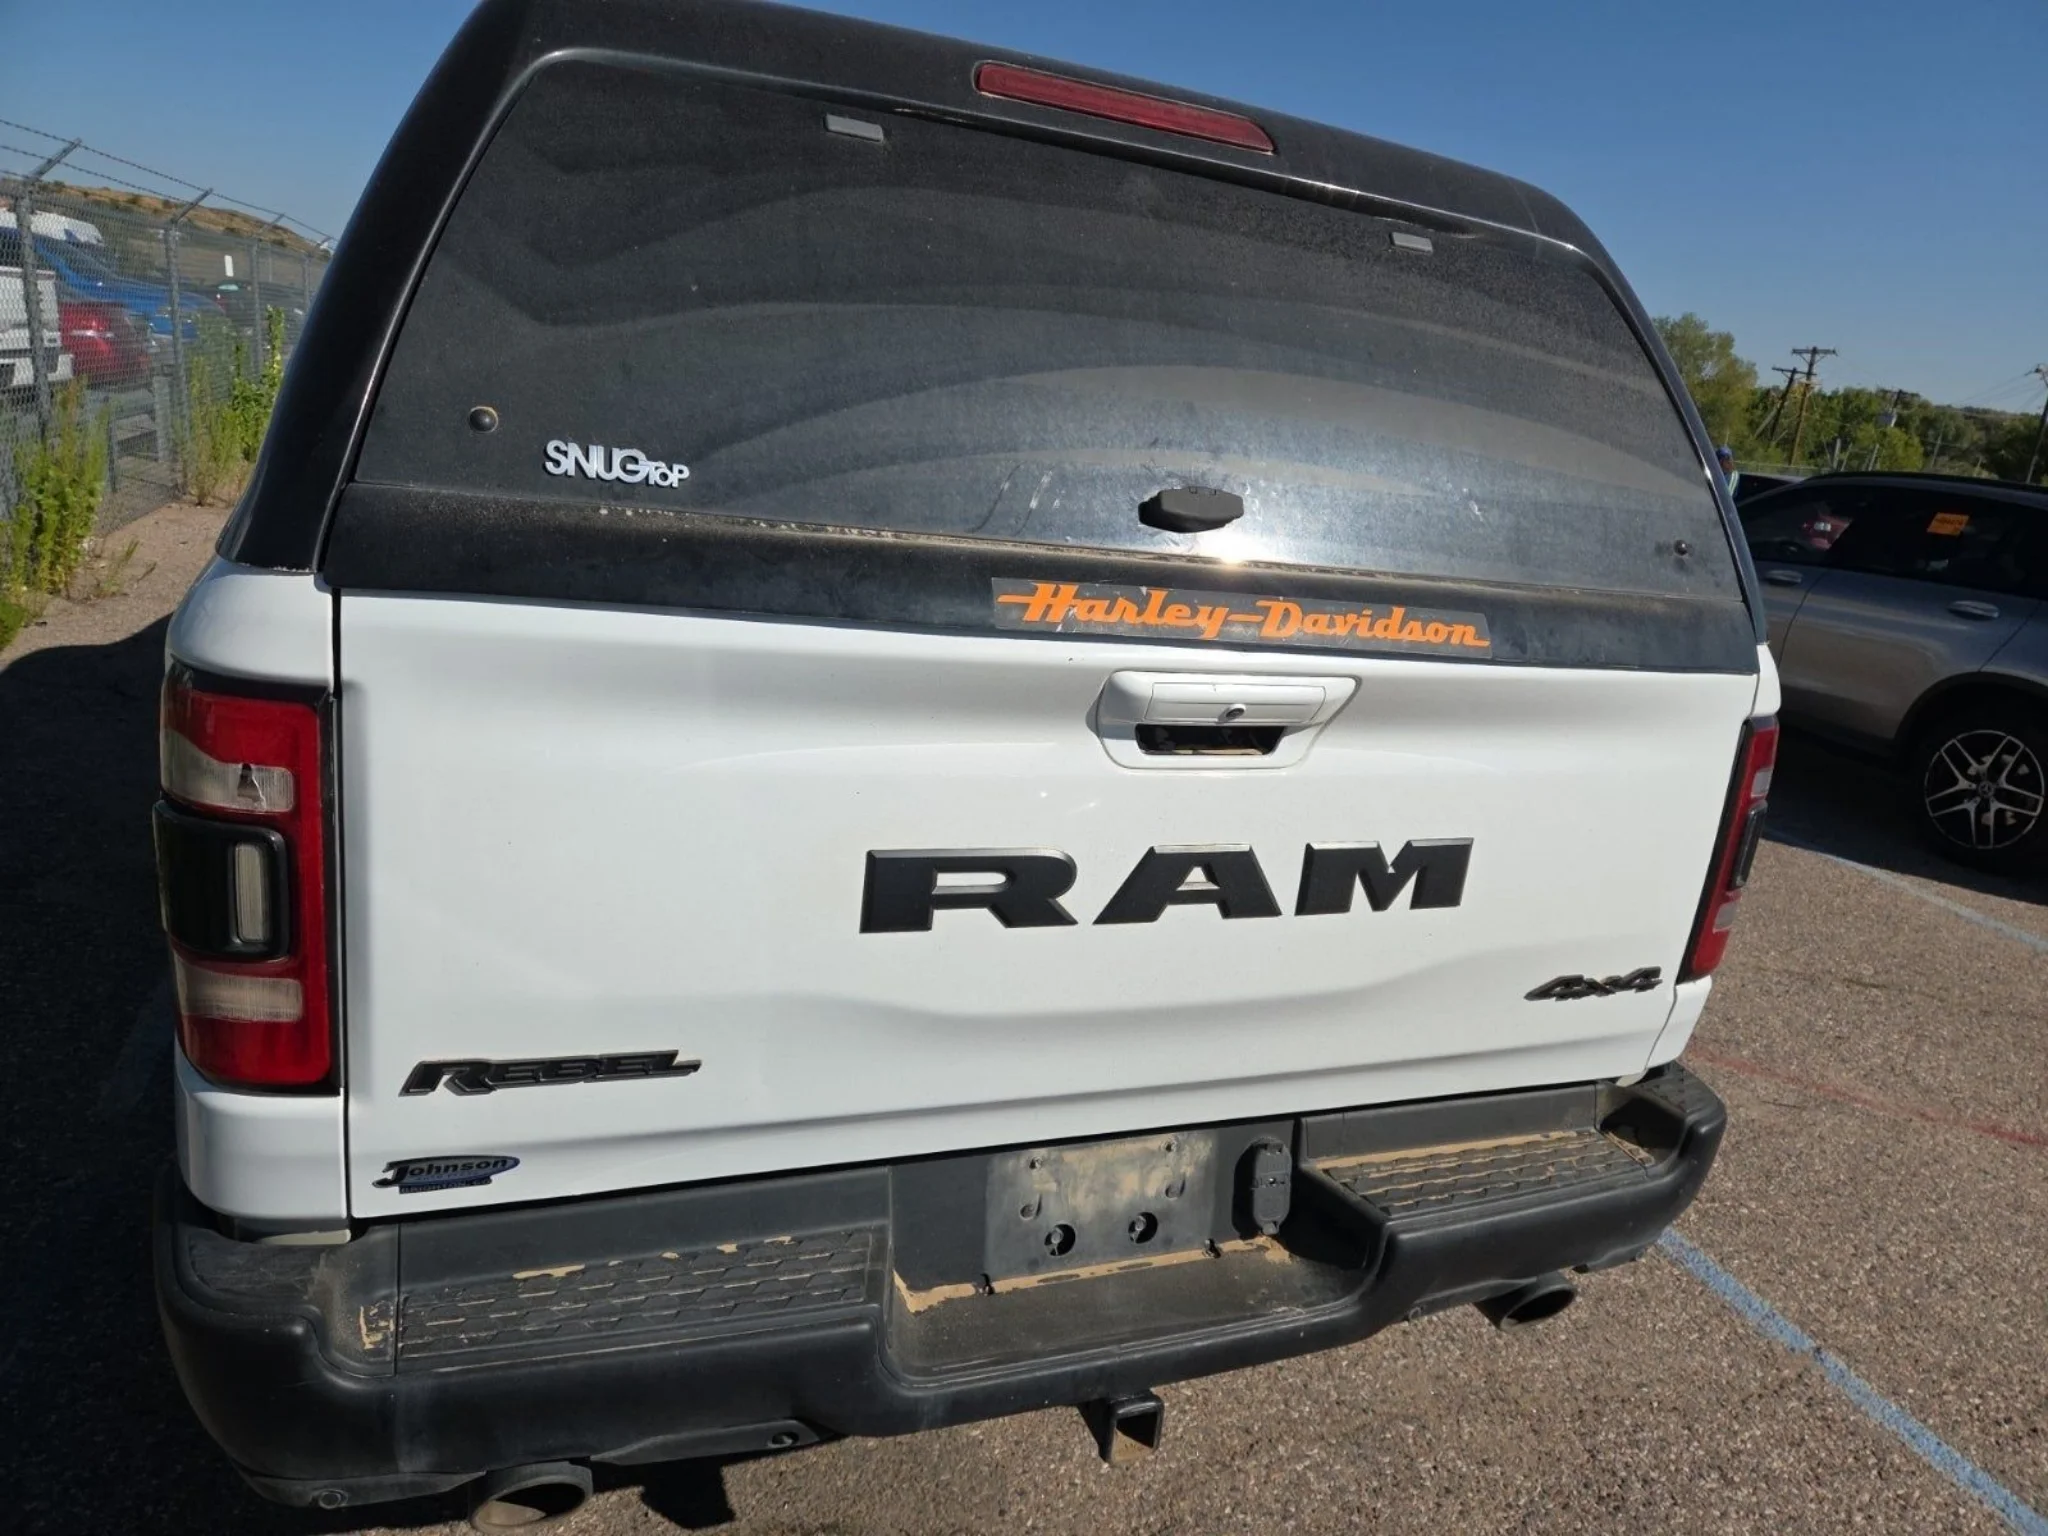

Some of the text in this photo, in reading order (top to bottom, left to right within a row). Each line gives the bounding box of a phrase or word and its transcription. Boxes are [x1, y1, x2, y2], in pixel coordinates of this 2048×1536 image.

[997, 581, 1491, 649] Harley-Davidson
[859, 837, 1474, 933] RAM
[398, 1049, 702, 1097] REBEL
[372, 1156, 508, 1188] Johnson
